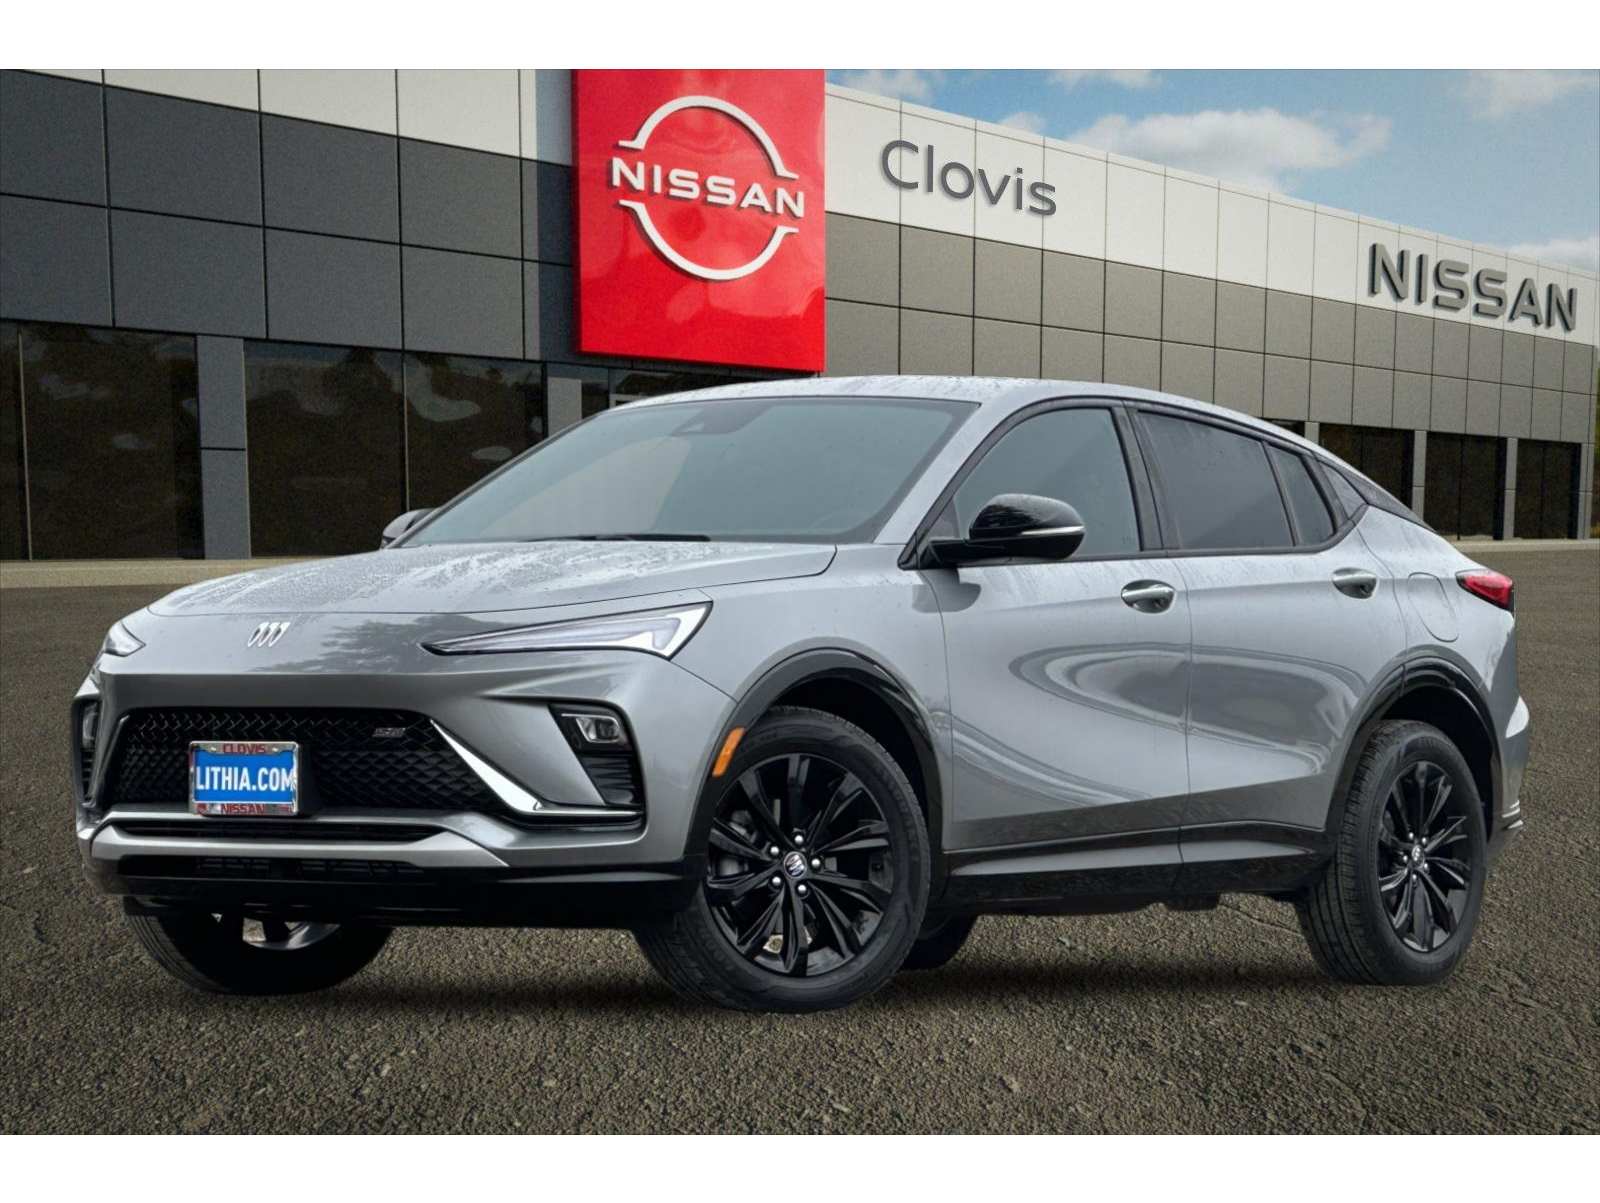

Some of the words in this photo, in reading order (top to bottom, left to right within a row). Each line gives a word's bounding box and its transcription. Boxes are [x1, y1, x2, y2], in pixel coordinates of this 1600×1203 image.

[611, 156, 805, 218] NISSAN
[881, 139, 1058, 216] Clovis
[1368, 243, 1578, 332] NISSAN
[222, 743, 266, 754] CLOVIS
[195, 766, 294, 792] LITHIA.COM
[222, 803, 266, 814] NISSAN
